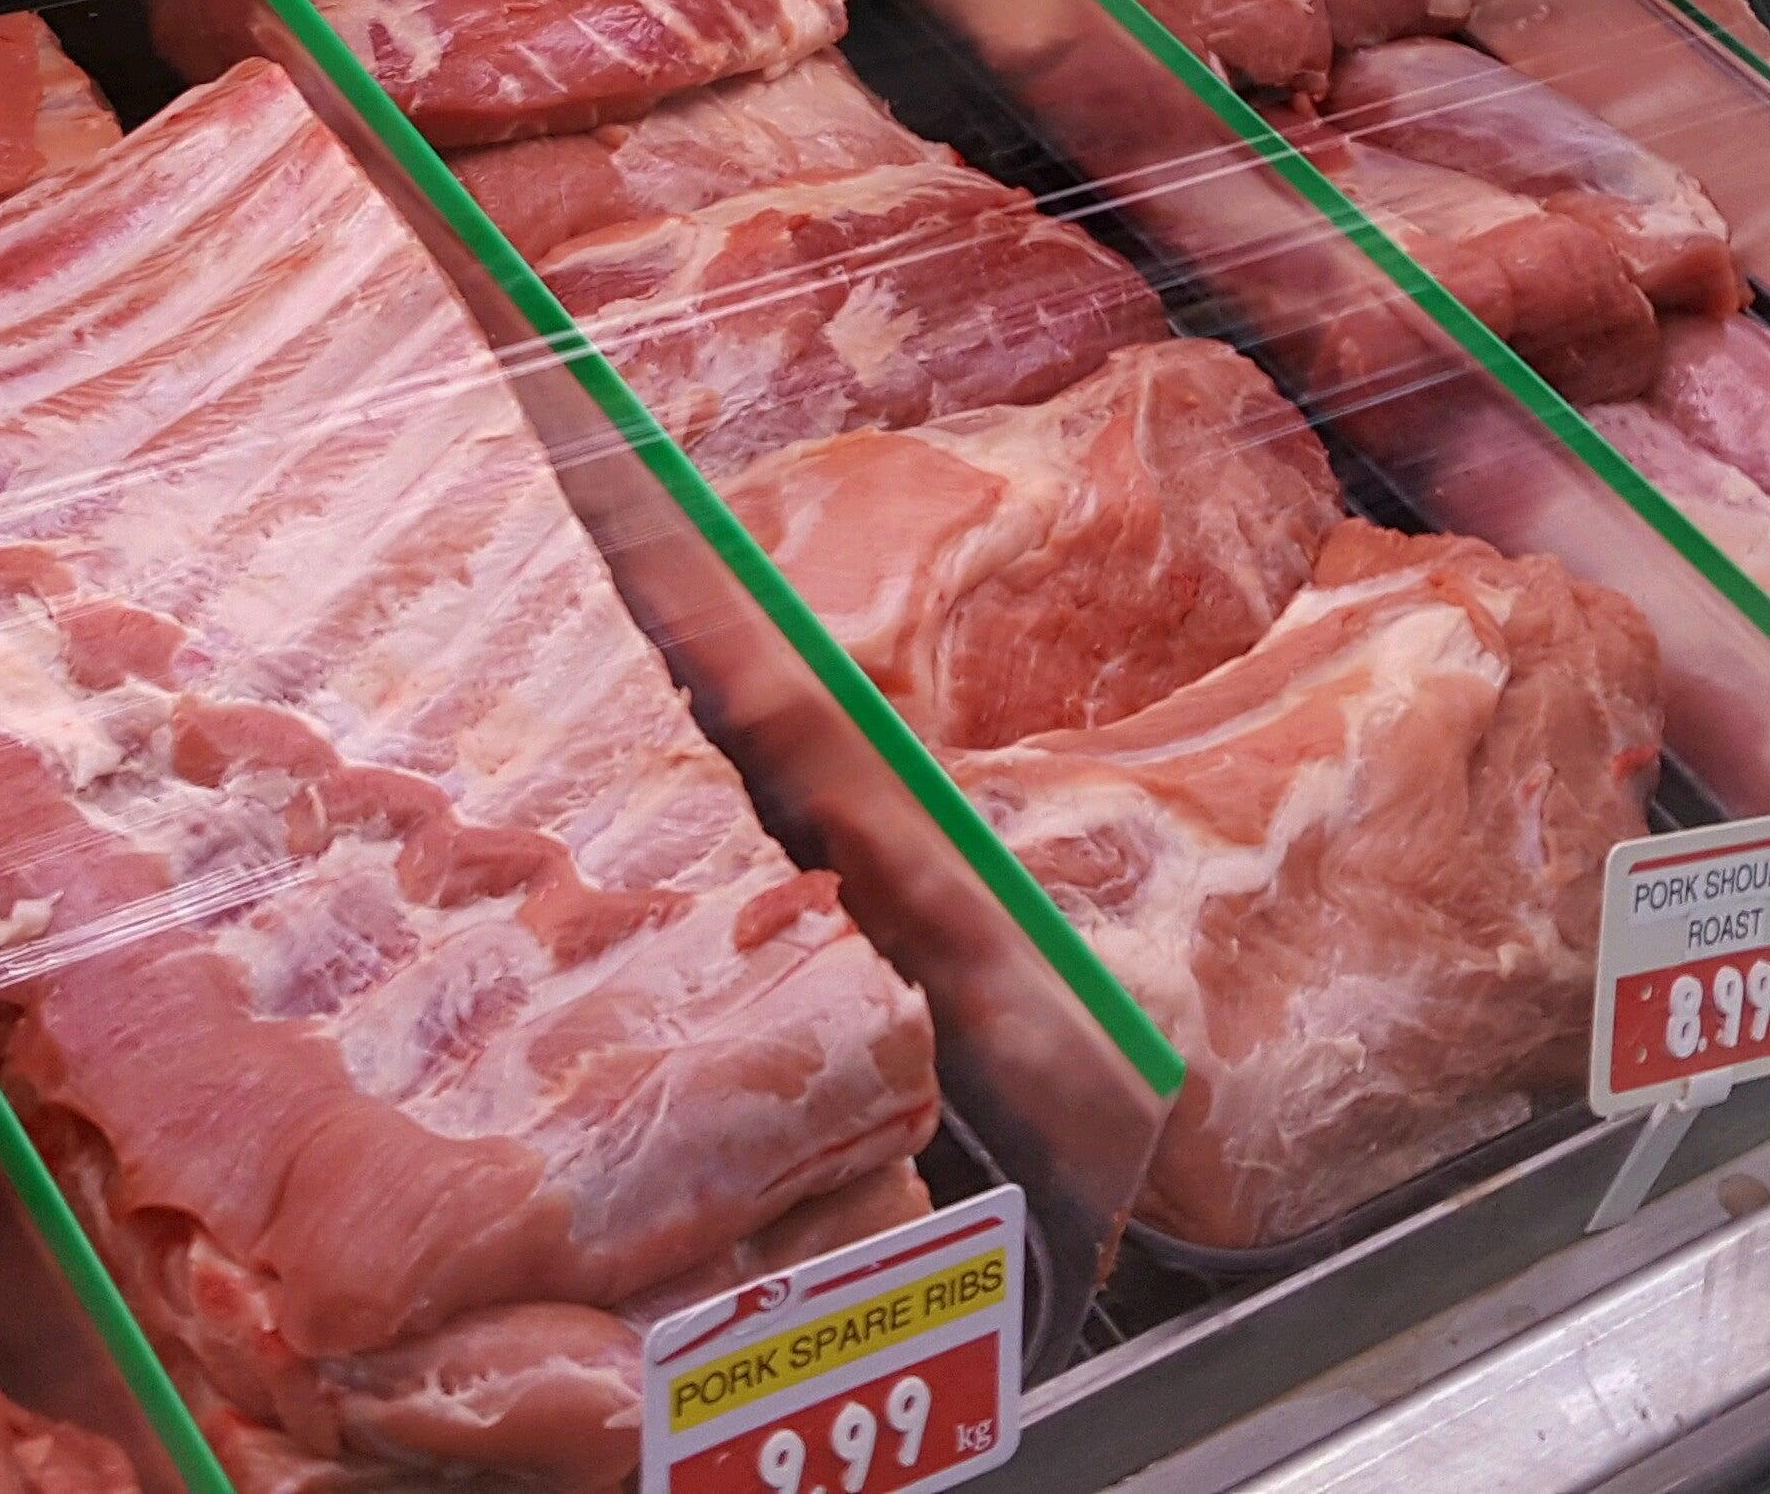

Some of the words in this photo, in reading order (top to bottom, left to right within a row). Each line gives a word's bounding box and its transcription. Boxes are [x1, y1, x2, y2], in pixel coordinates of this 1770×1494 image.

[1633, 873, 1700, 913] PORK
[1687, 908, 1764, 949] ROAST
[674, 1347, 778, 1418] PORK
[789, 1300, 915, 1370] SPARE
[923, 1259, 1005, 1318] RIBS
[757, 1374, 931, 1494] 9.99
[955, 1417, 993, 1453] kg
